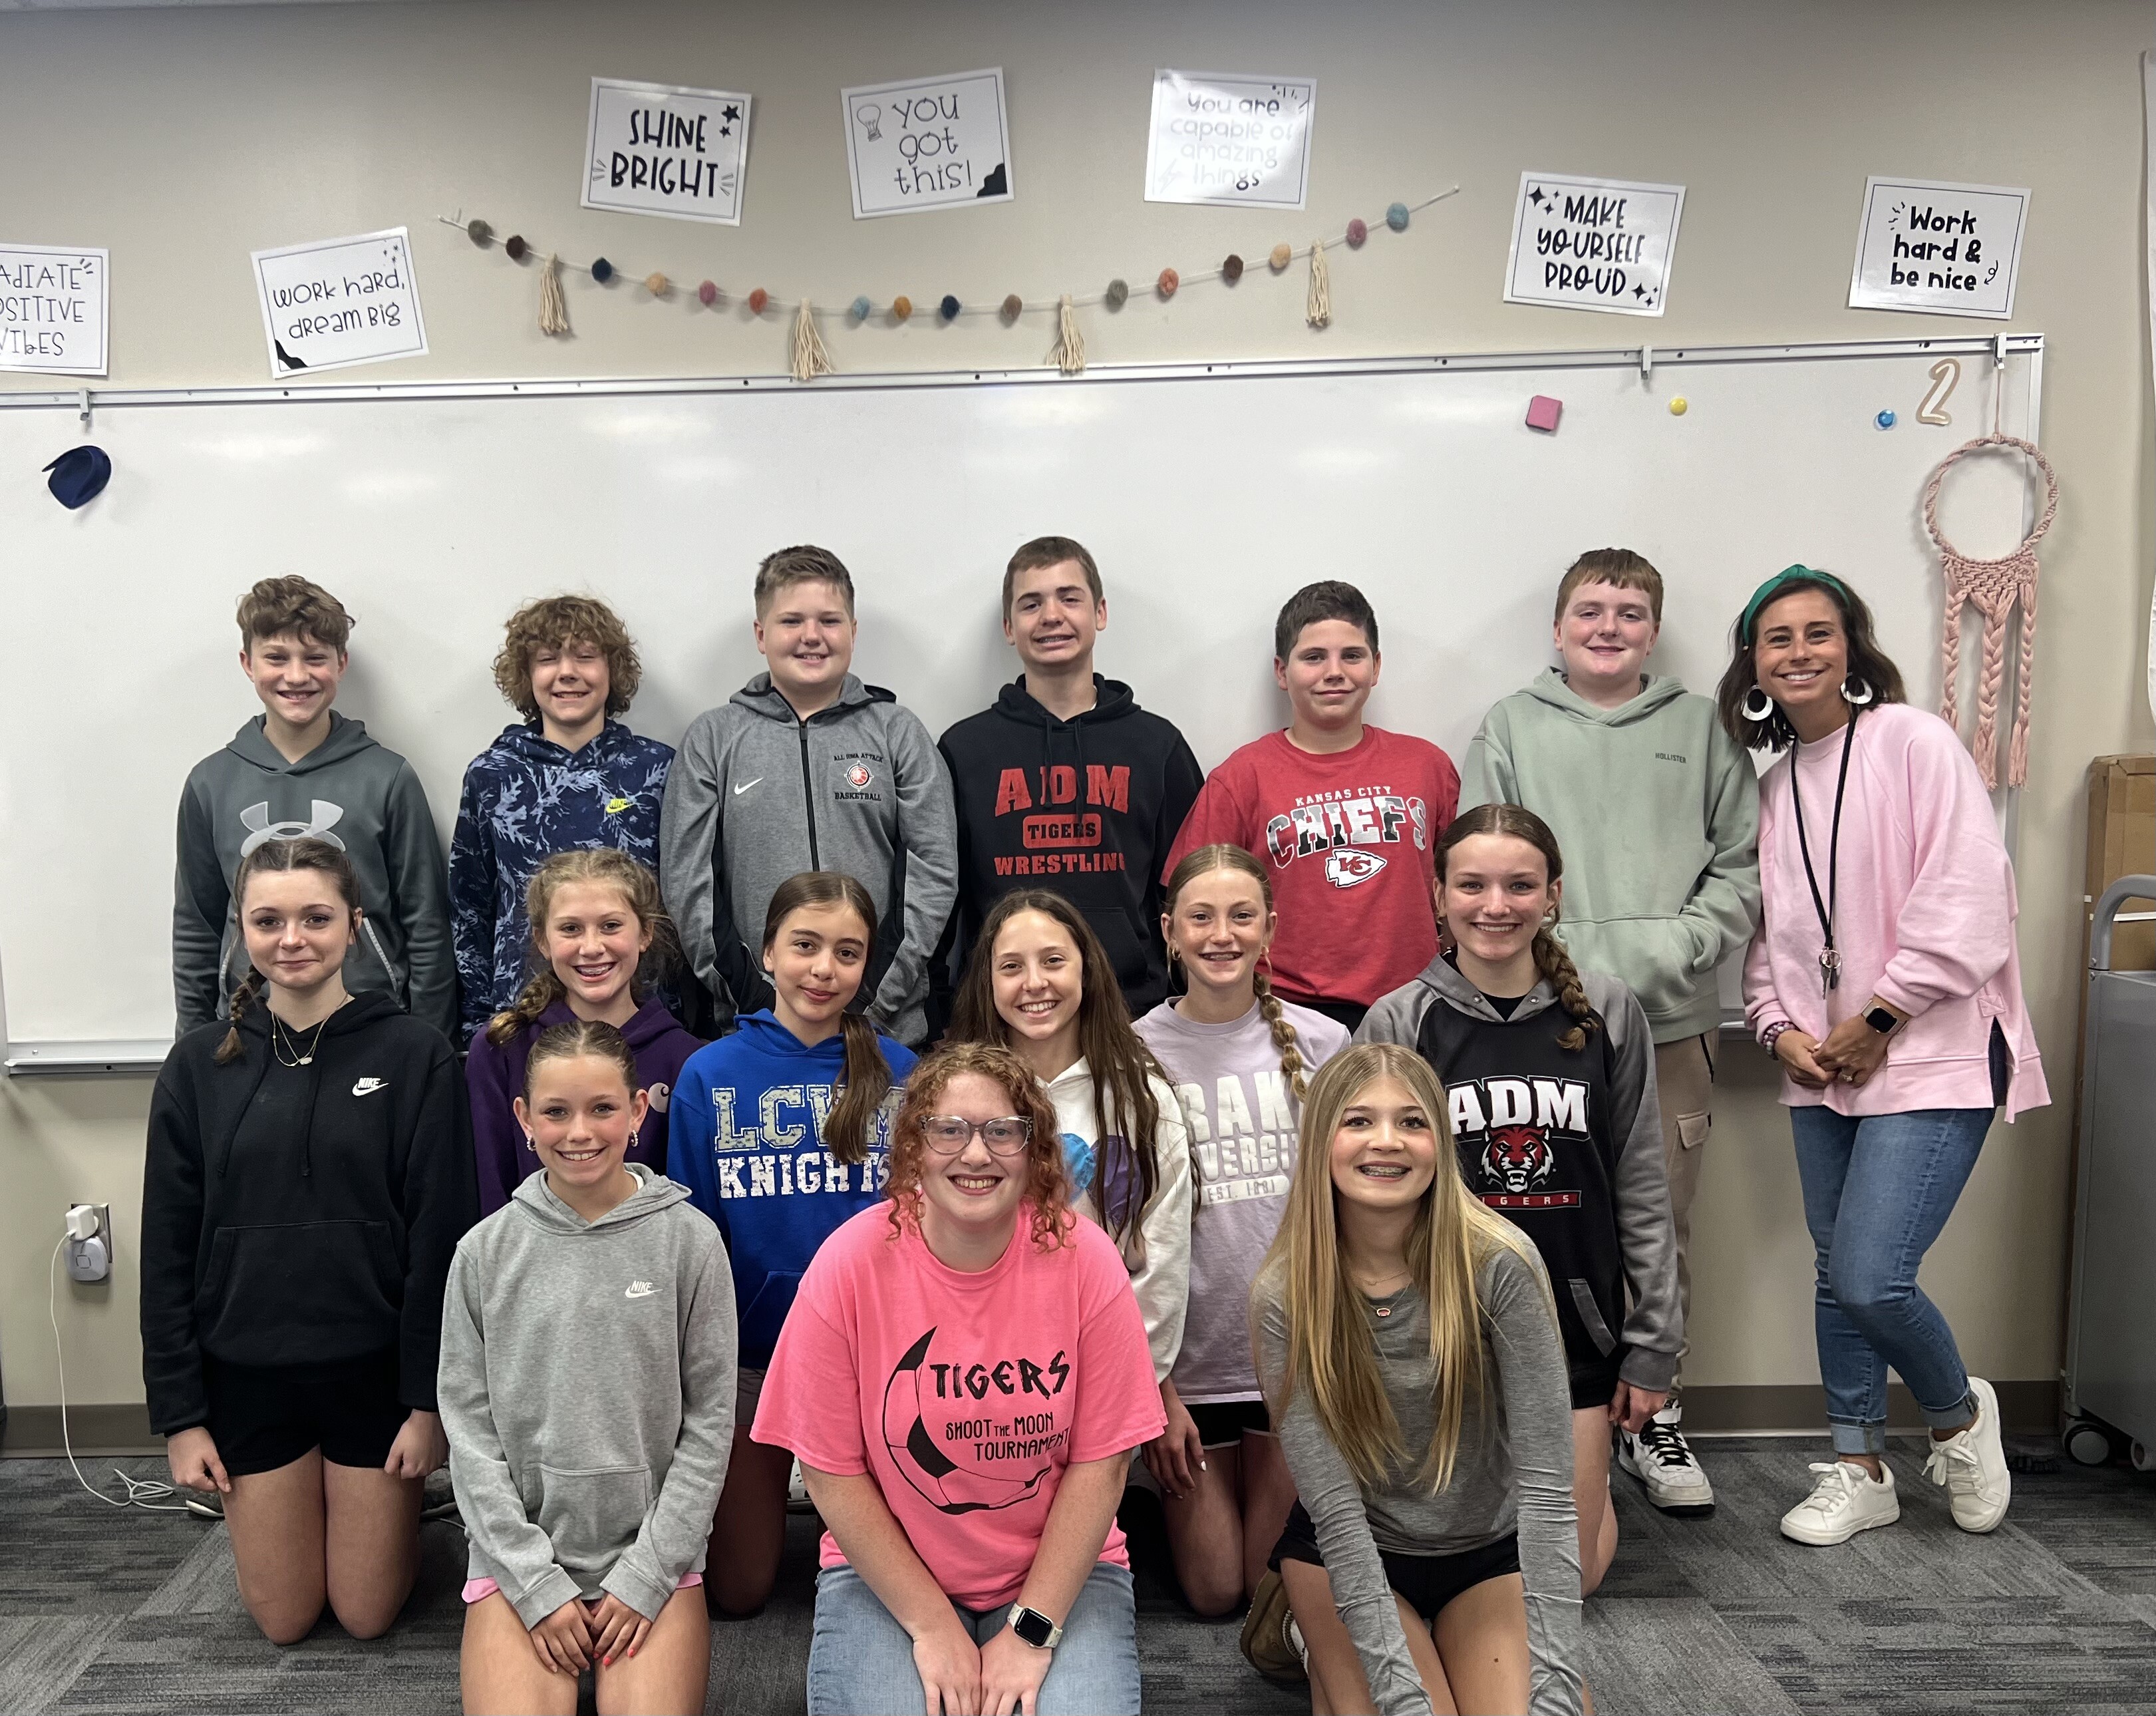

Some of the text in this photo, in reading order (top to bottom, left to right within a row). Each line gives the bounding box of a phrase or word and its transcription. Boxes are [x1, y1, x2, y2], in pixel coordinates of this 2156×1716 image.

[1187, 92, 1280, 116] you are
[629, 110, 707, 153] SHINE
[1170, 117, 1263, 142] capable
[899, 126, 959, 166] got
[1180, 142, 1277, 168] amazing
[611, 151, 718, 198] BRIGHT
[894, 159, 972, 194] this!
[1564, 195, 1627, 229] MAKE
[1910, 206, 1976, 234] Work
[1537, 228, 1645, 264] YOURSELF
[1893, 234, 1982, 264] hard &
[1545, 261, 1626, 297] PROUD
[1891, 262, 1977, 291] be nice
[0, 295, 86, 322] SITIVE
[861, 753, 884, 763] ATTACK
[1655, 753, 1687, 764] HOLLISTER
[834, 792, 882, 802] BASKETBALL
[995, 765, 1130, 817] ADM
[1295, 786, 1392, 807] KANSAS CITY
[1027, 822, 1097, 840] TIGERS
[1266, 796, 1427, 869] CHIEFS
[357, 1077, 381, 1089] NIKE
[1173, 1068, 1301, 1142] RAK
[1448, 1079, 1588, 1135] ADM
[1191, 1132, 1300, 1182] VERSI
[1481, 1194, 1569, 1206] IGERS
[631, 1280, 653, 1293] NIKE
[929, 1350, 1070, 1400] TIGERS
[945, 1411, 1054, 1441] SHOOT THE MOON
[974, 1427, 1070, 1461] TOURNAMENT
